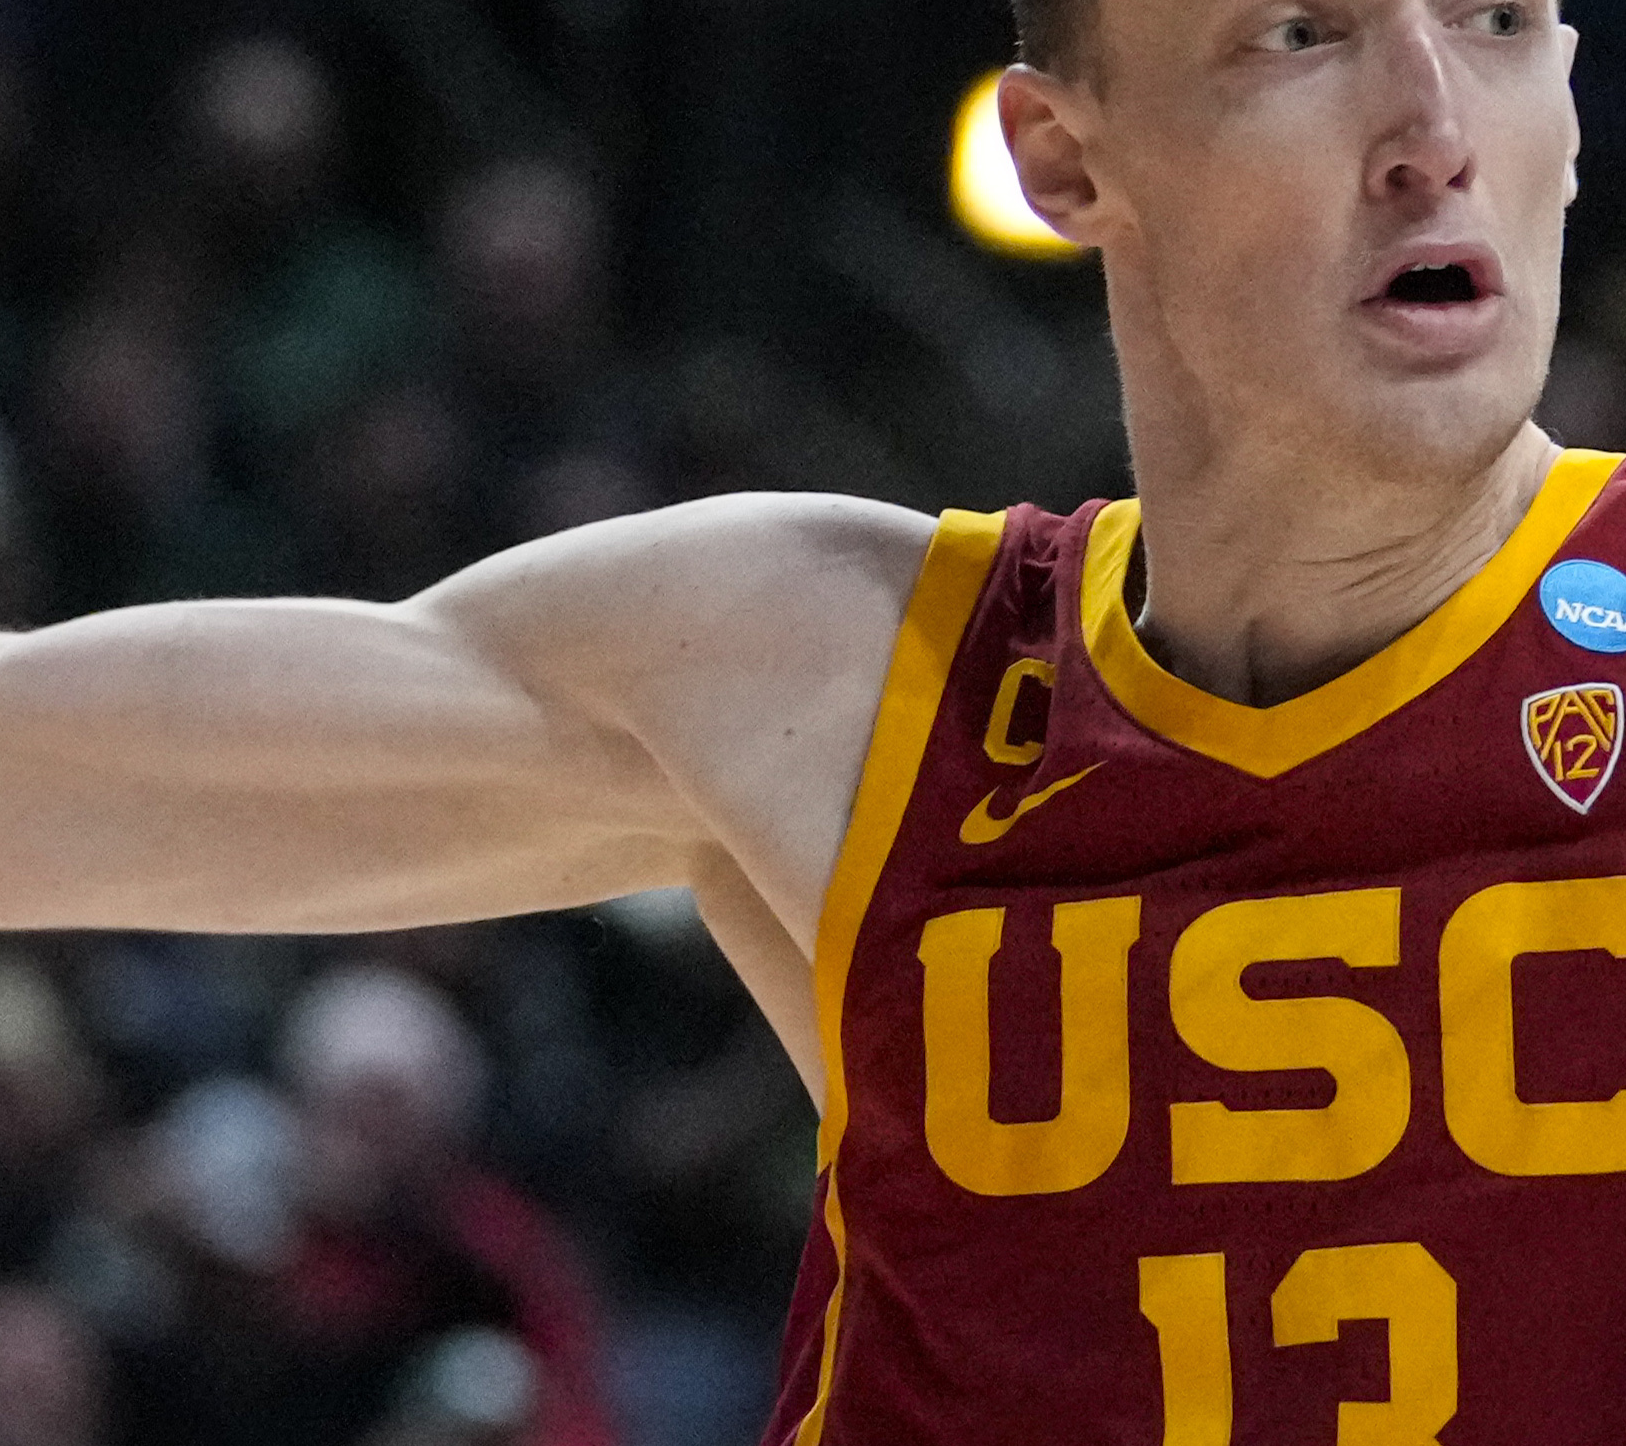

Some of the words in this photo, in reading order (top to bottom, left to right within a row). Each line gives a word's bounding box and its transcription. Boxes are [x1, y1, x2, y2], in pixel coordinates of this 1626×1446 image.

[983, 657, 1056, 767] C
[1528, 689, 1617, 762] PAC
[1553, 734, 1601, 782] 12
